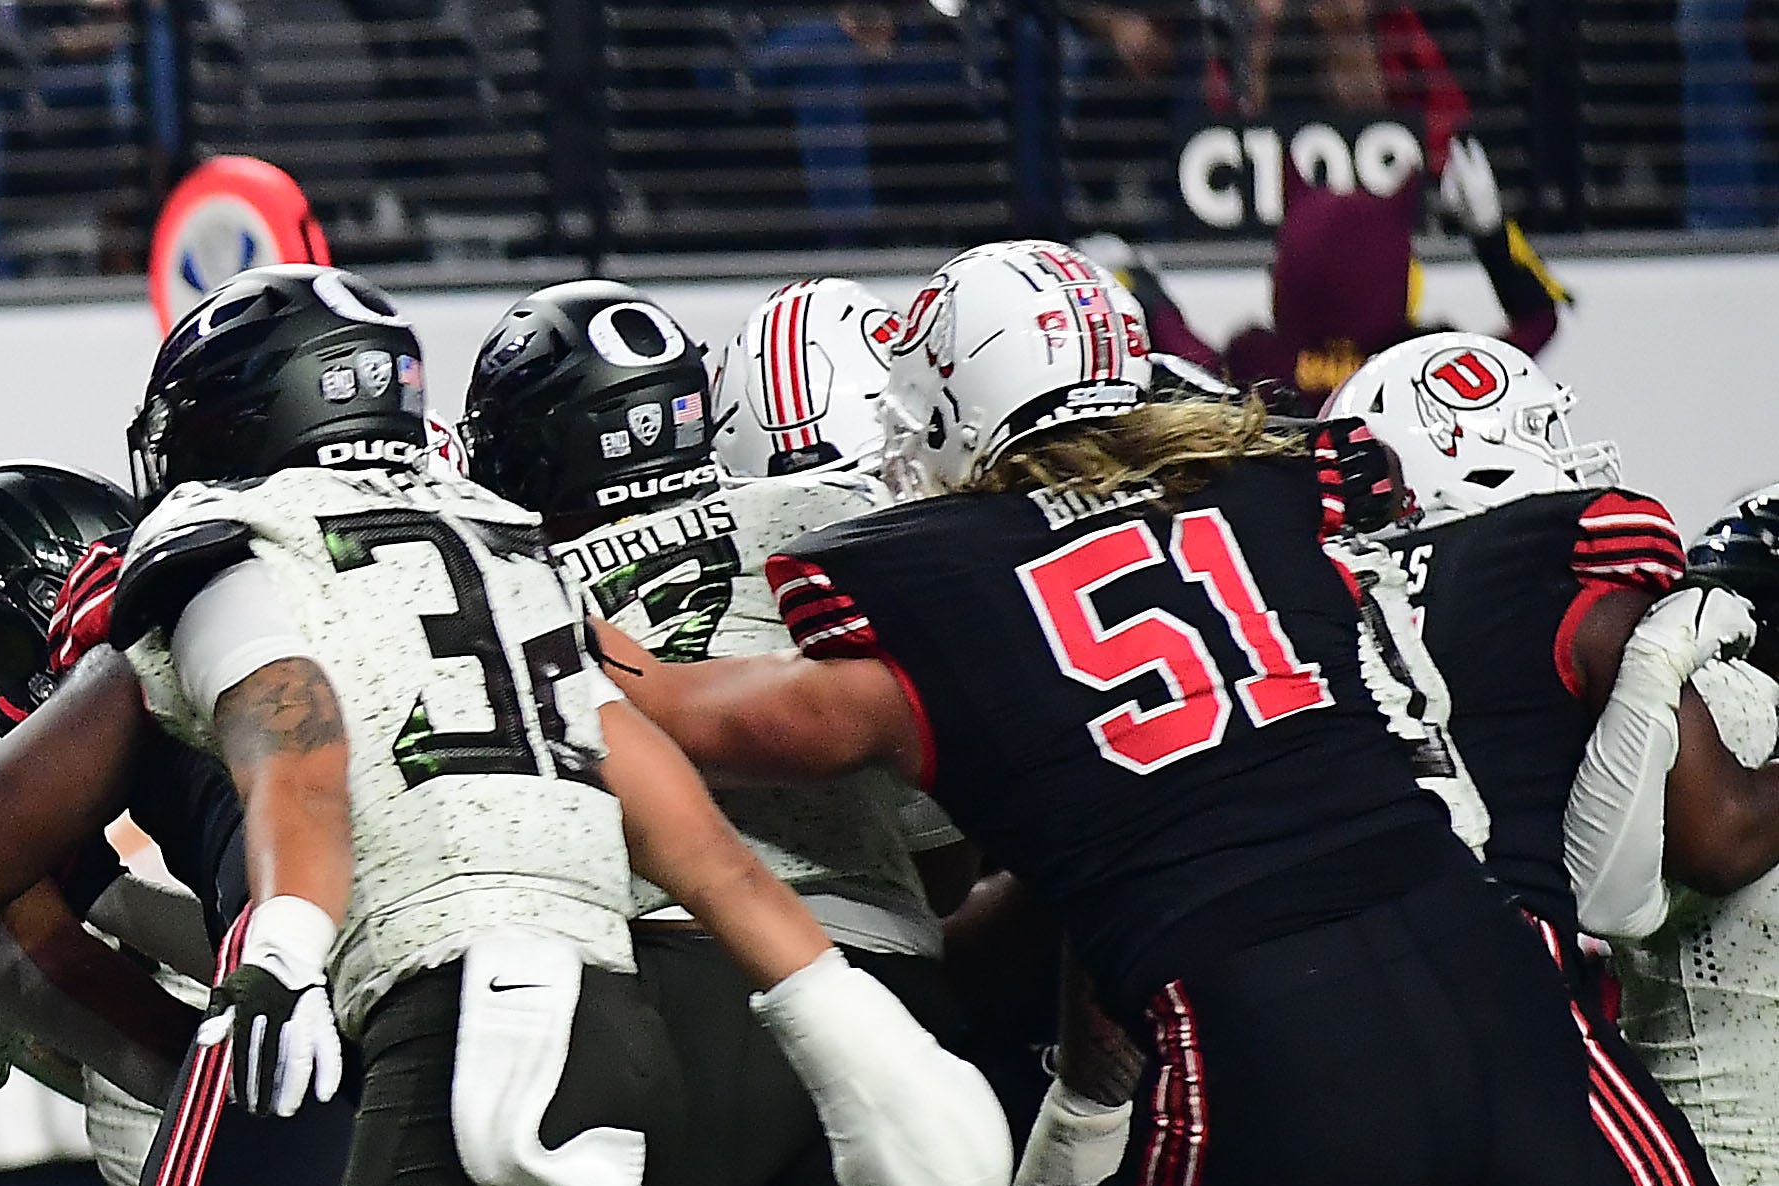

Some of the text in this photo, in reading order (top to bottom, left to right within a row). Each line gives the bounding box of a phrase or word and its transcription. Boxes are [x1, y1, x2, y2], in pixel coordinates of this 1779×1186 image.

[587, 302, 686, 367] O
[1430, 351, 1498, 401] U
[596, 462, 718, 507] DUCKS
[1014, 507, 1334, 776] 51
